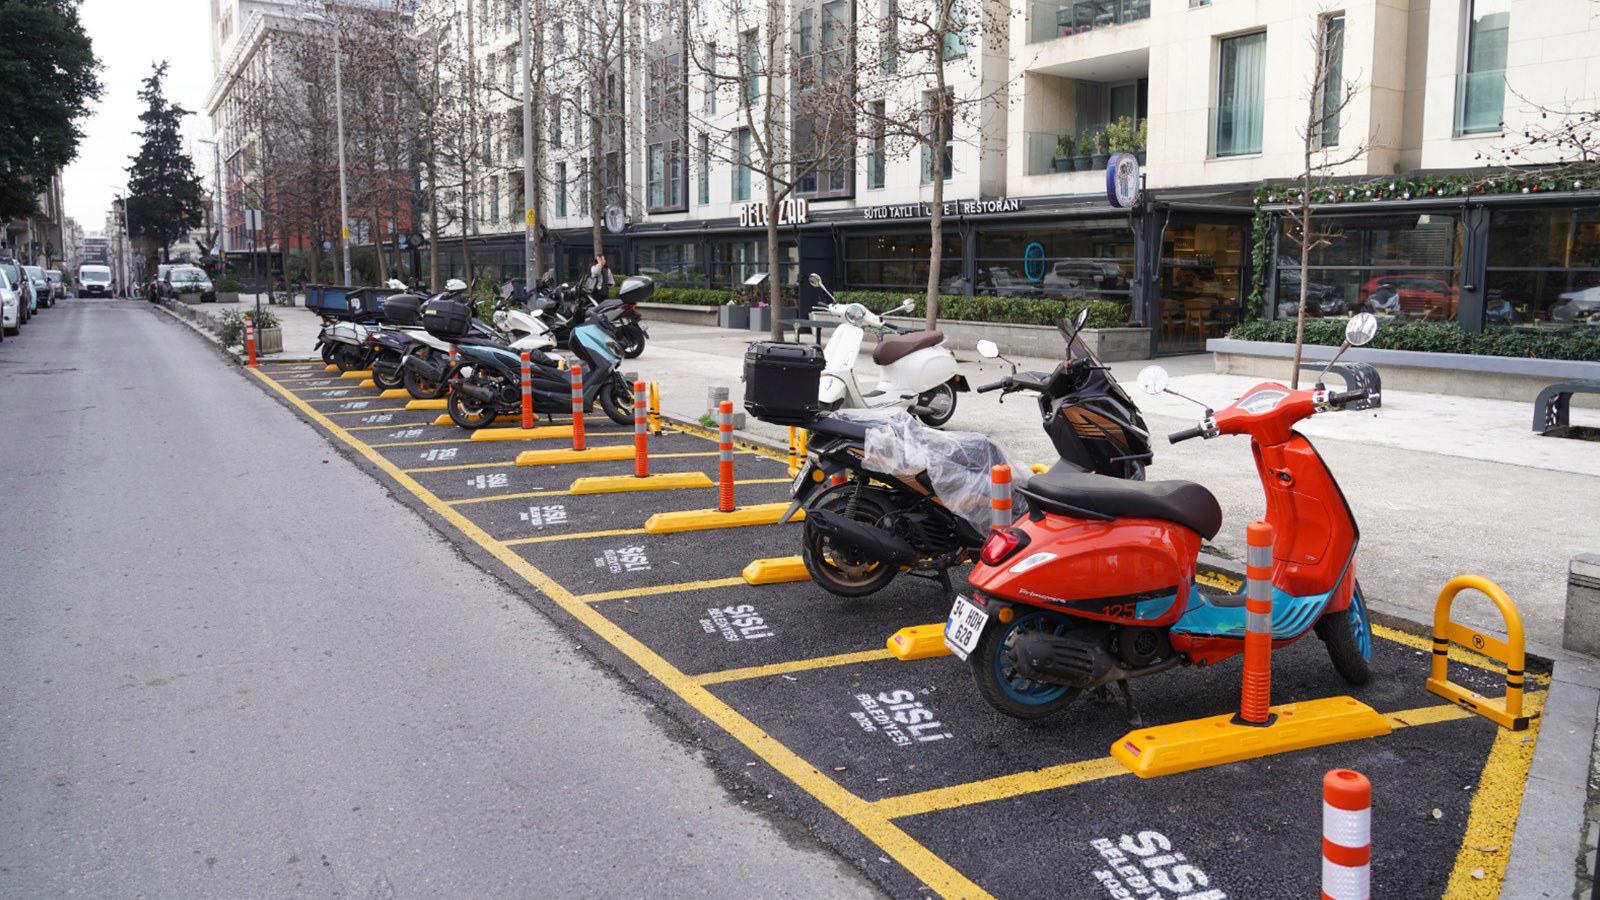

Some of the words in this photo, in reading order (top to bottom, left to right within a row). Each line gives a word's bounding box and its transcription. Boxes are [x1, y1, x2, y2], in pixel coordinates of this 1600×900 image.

[739, 198, 807, 227] BELGZAR
[925, 204, 950, 215] CE
[964, 199, 1019, 214] RESTORAN
[953, 600, 965, 618] 34
[965, 608, 984, 631] HDH
[1102, 603, 1136, 620] 125
[955, 624, 973, 646] 628
[1094, 869, 1136, 900] 202
